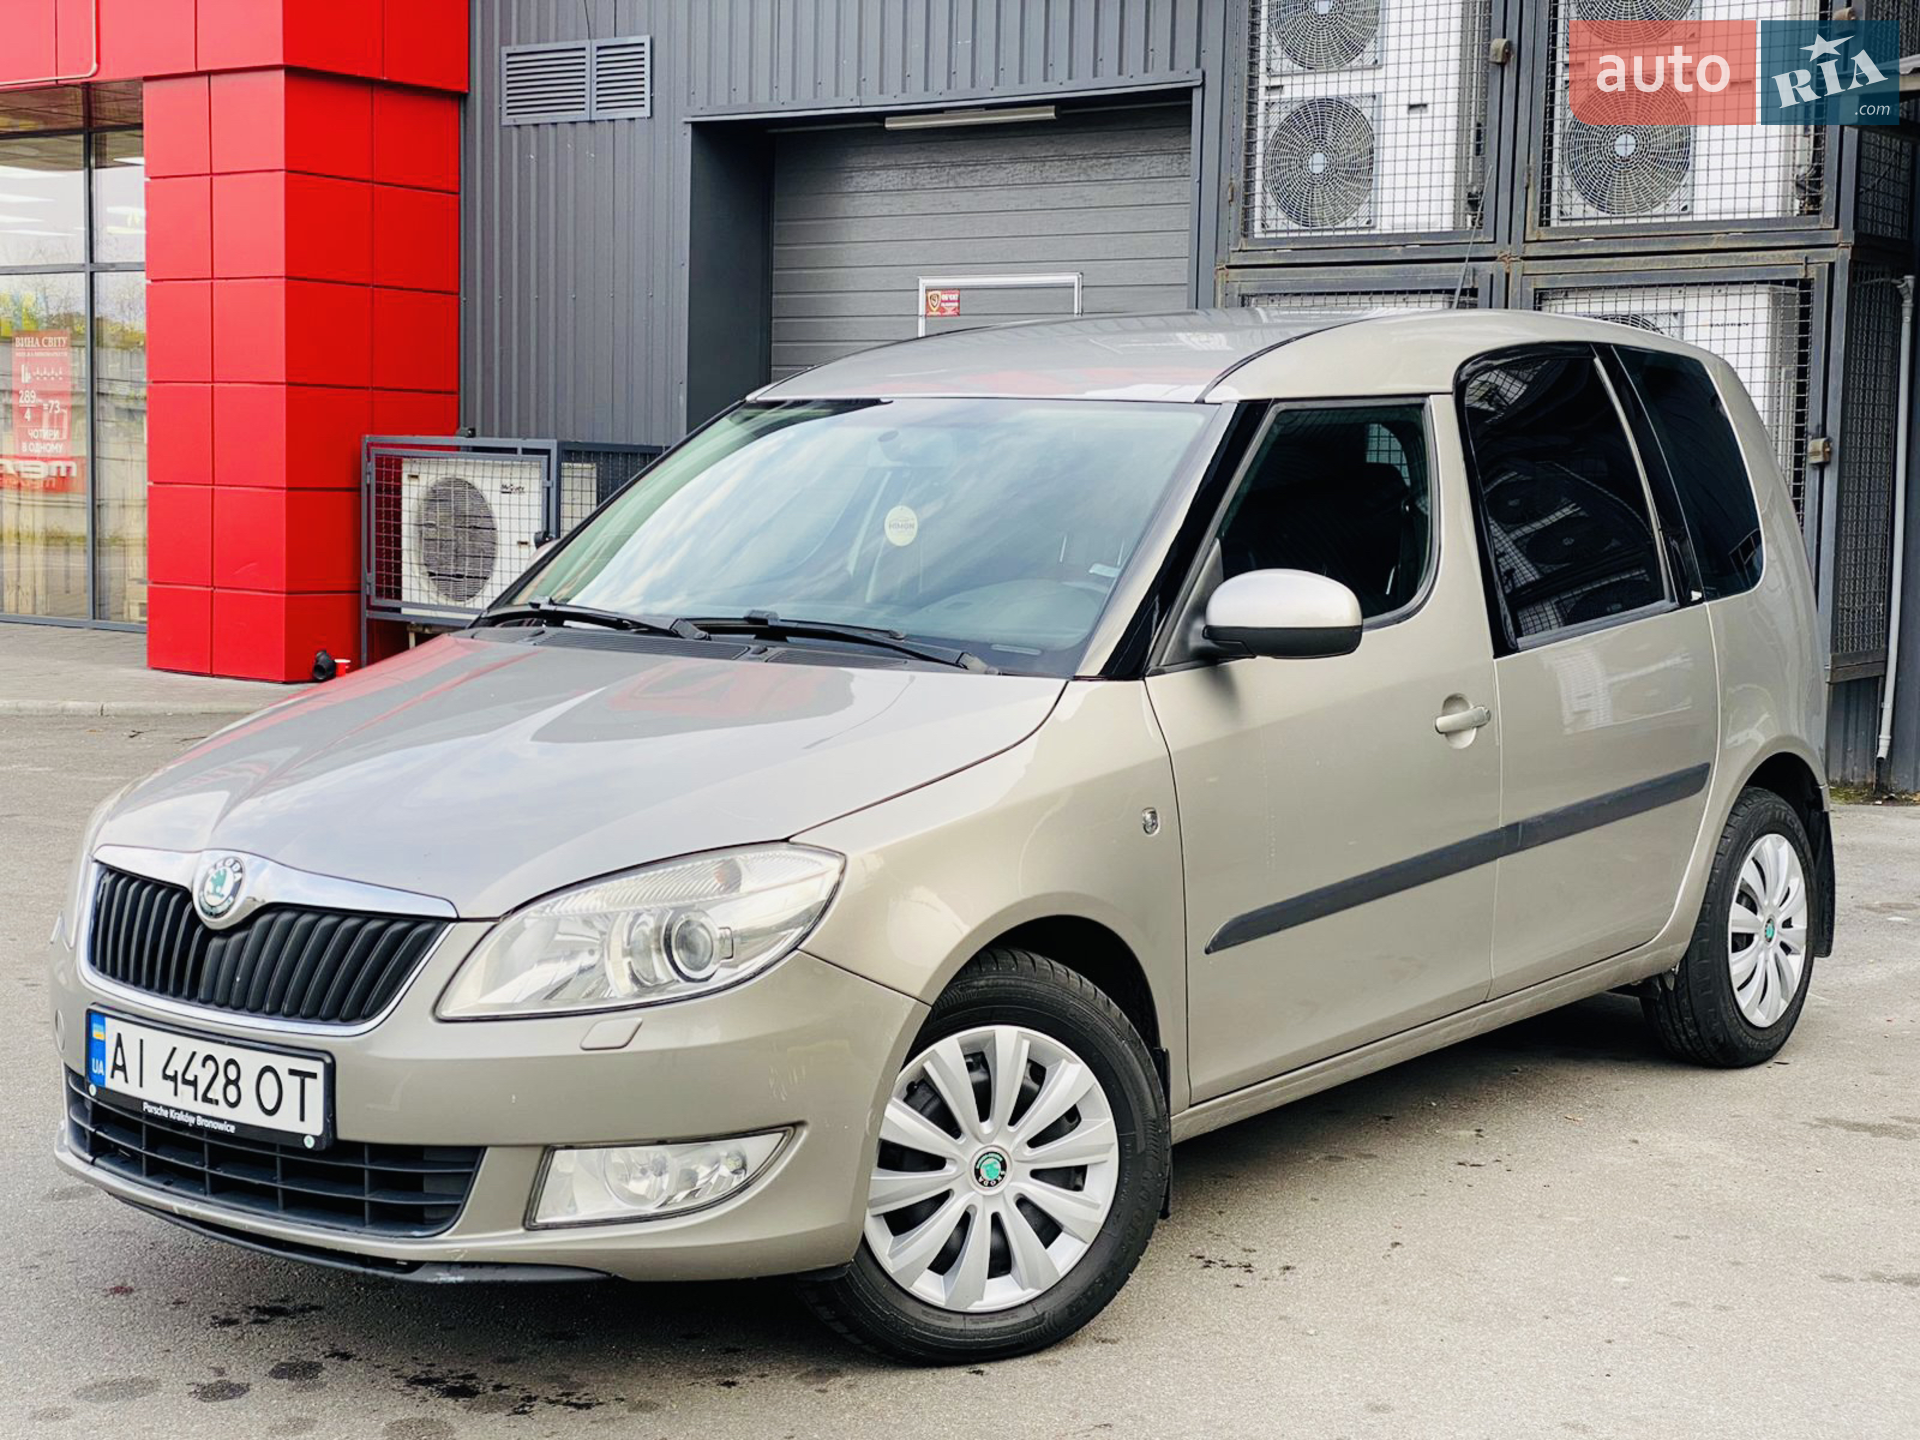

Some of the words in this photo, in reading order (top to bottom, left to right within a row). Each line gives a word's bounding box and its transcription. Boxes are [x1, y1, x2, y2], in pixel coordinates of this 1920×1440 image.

[15, 336, 41, 347] ВИНА
[19, 390, 36, 403] 289
[24, 408, 31, 422] 4
[92, 1058, 105, 1076] UA
[110, 1032, 144, 1088] AI
[162, 1046, 242, 1109] 4428
[255, 1065, 318, 1122] OT
[142, 1101, 169, 1117] Porsche
[196, 1115, 236, 1133] Bronowice
